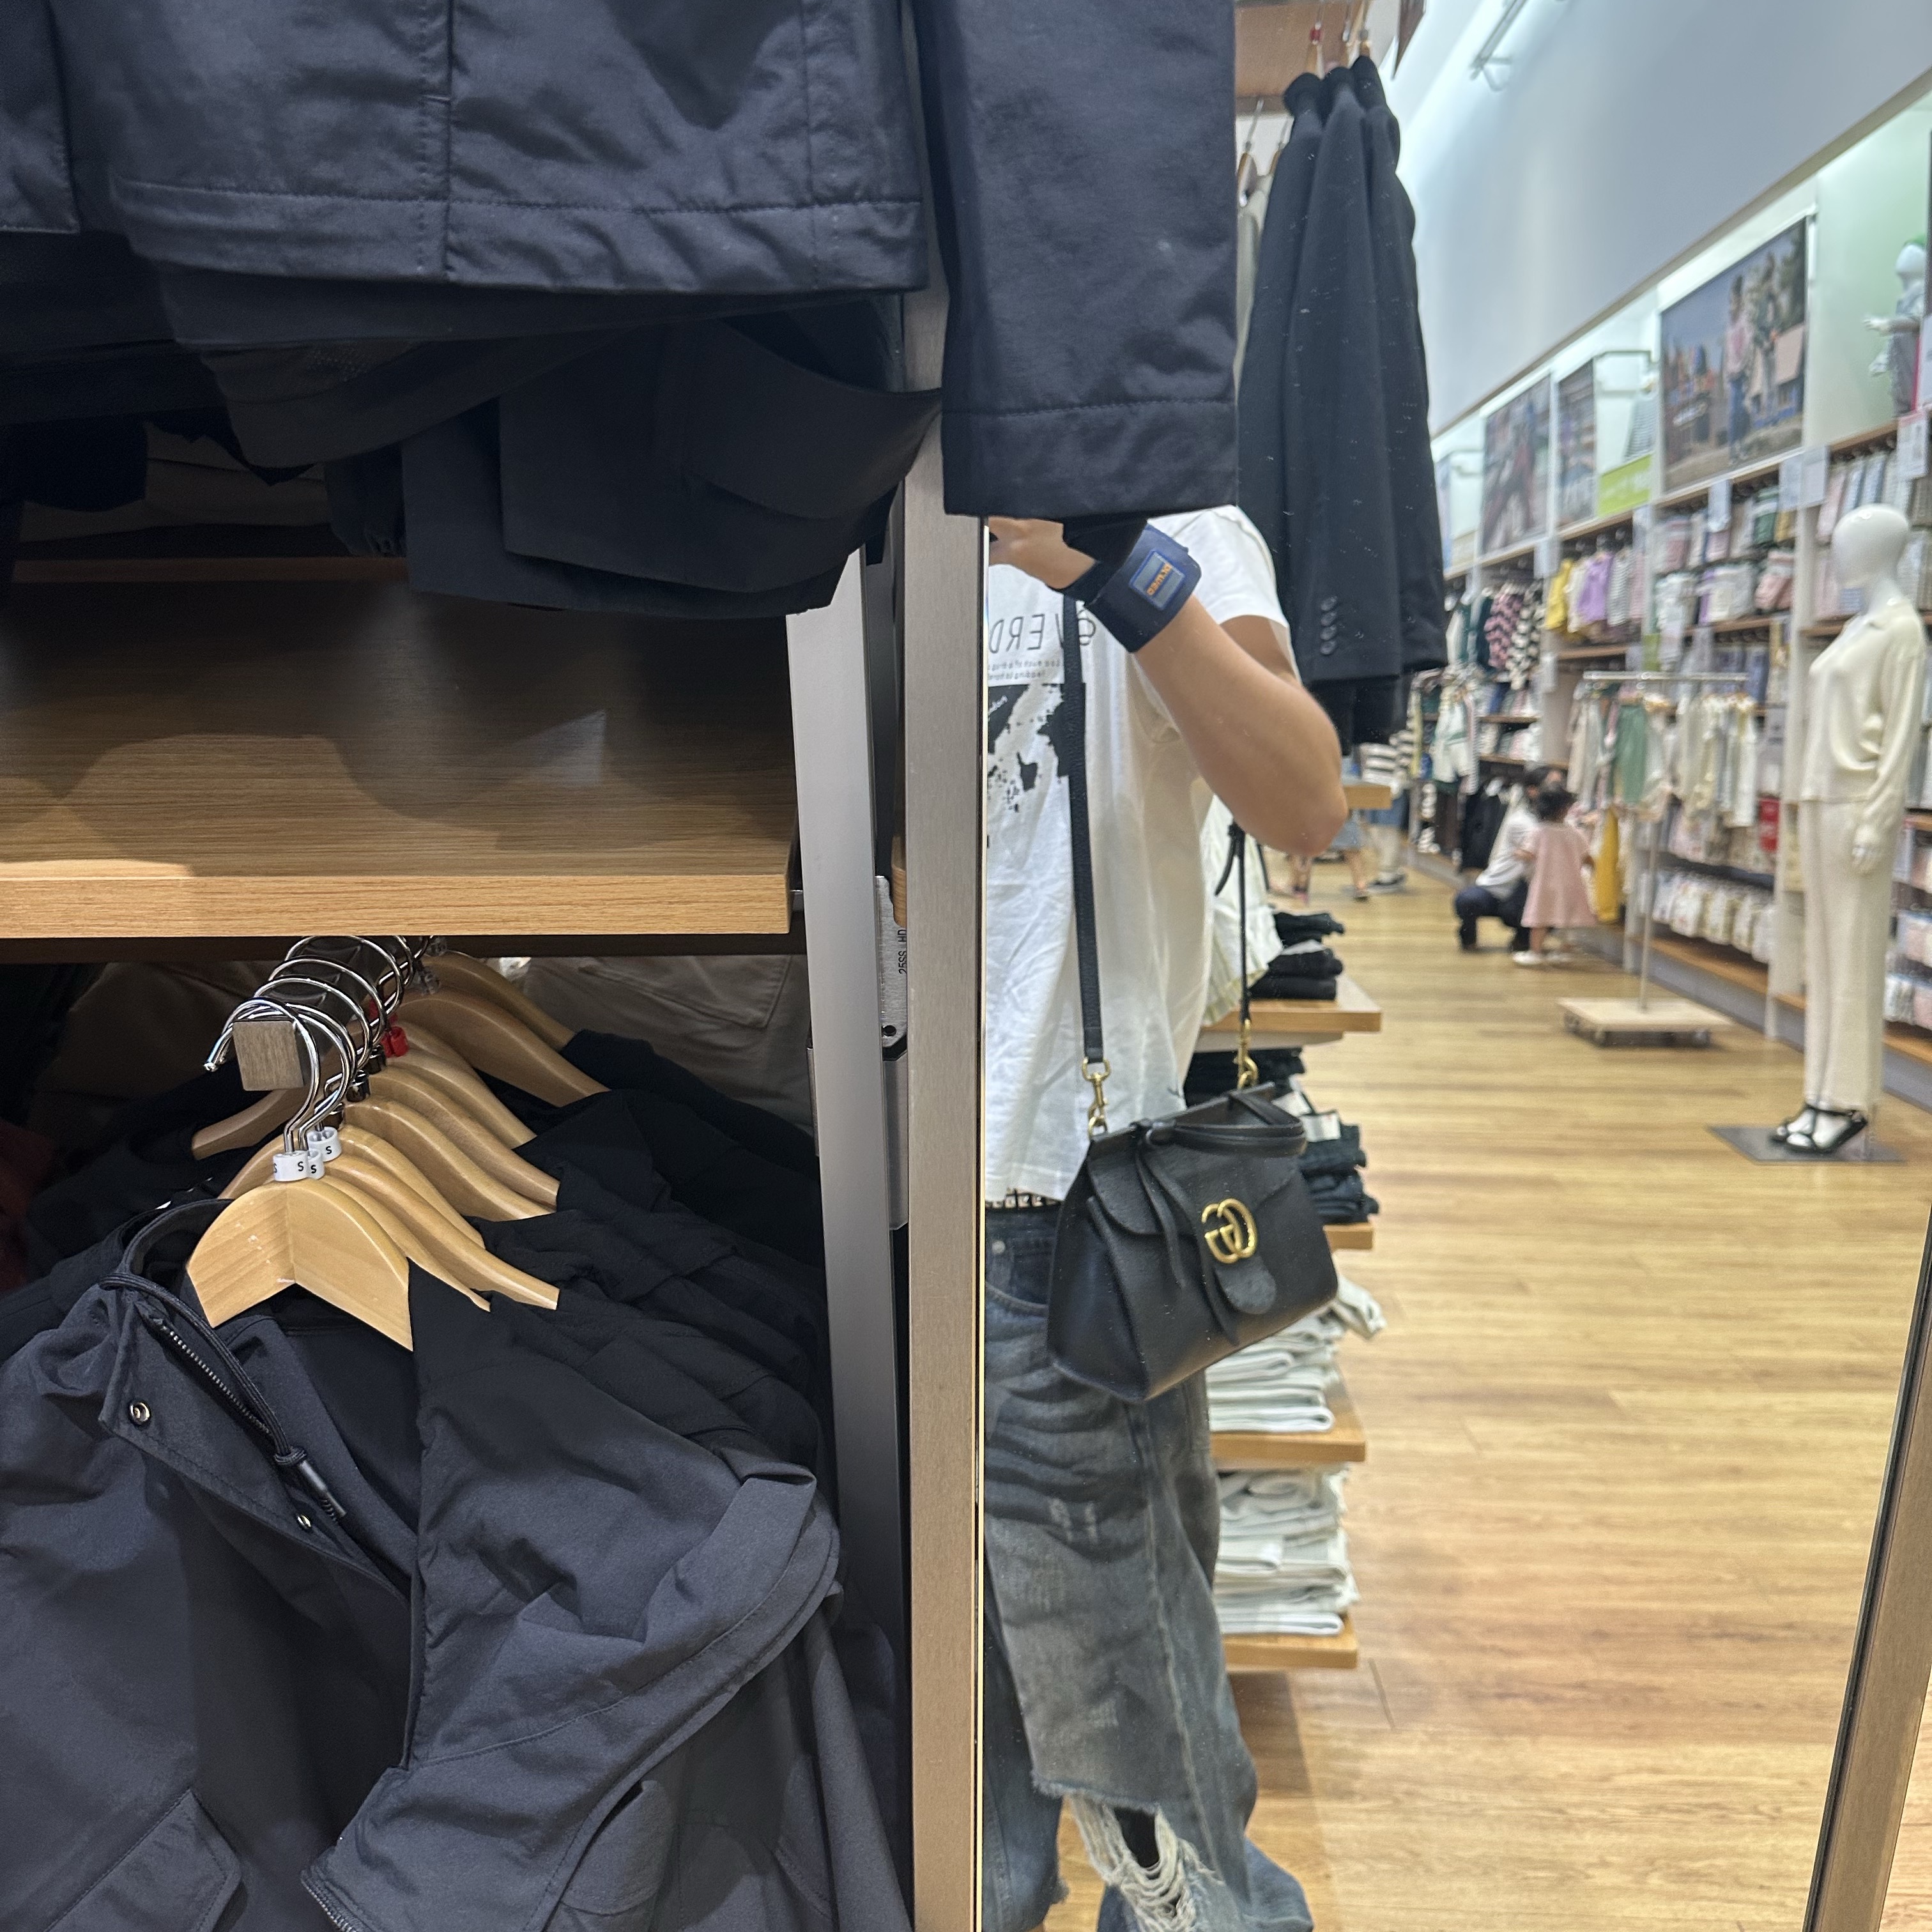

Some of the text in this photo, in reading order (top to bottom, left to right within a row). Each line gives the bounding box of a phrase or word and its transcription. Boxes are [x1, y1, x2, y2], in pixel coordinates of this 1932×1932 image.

[325, 1146, 332, 1154] S
[297, 1161, 304, 1172] S
[310, 1165, 317, 1174] S
